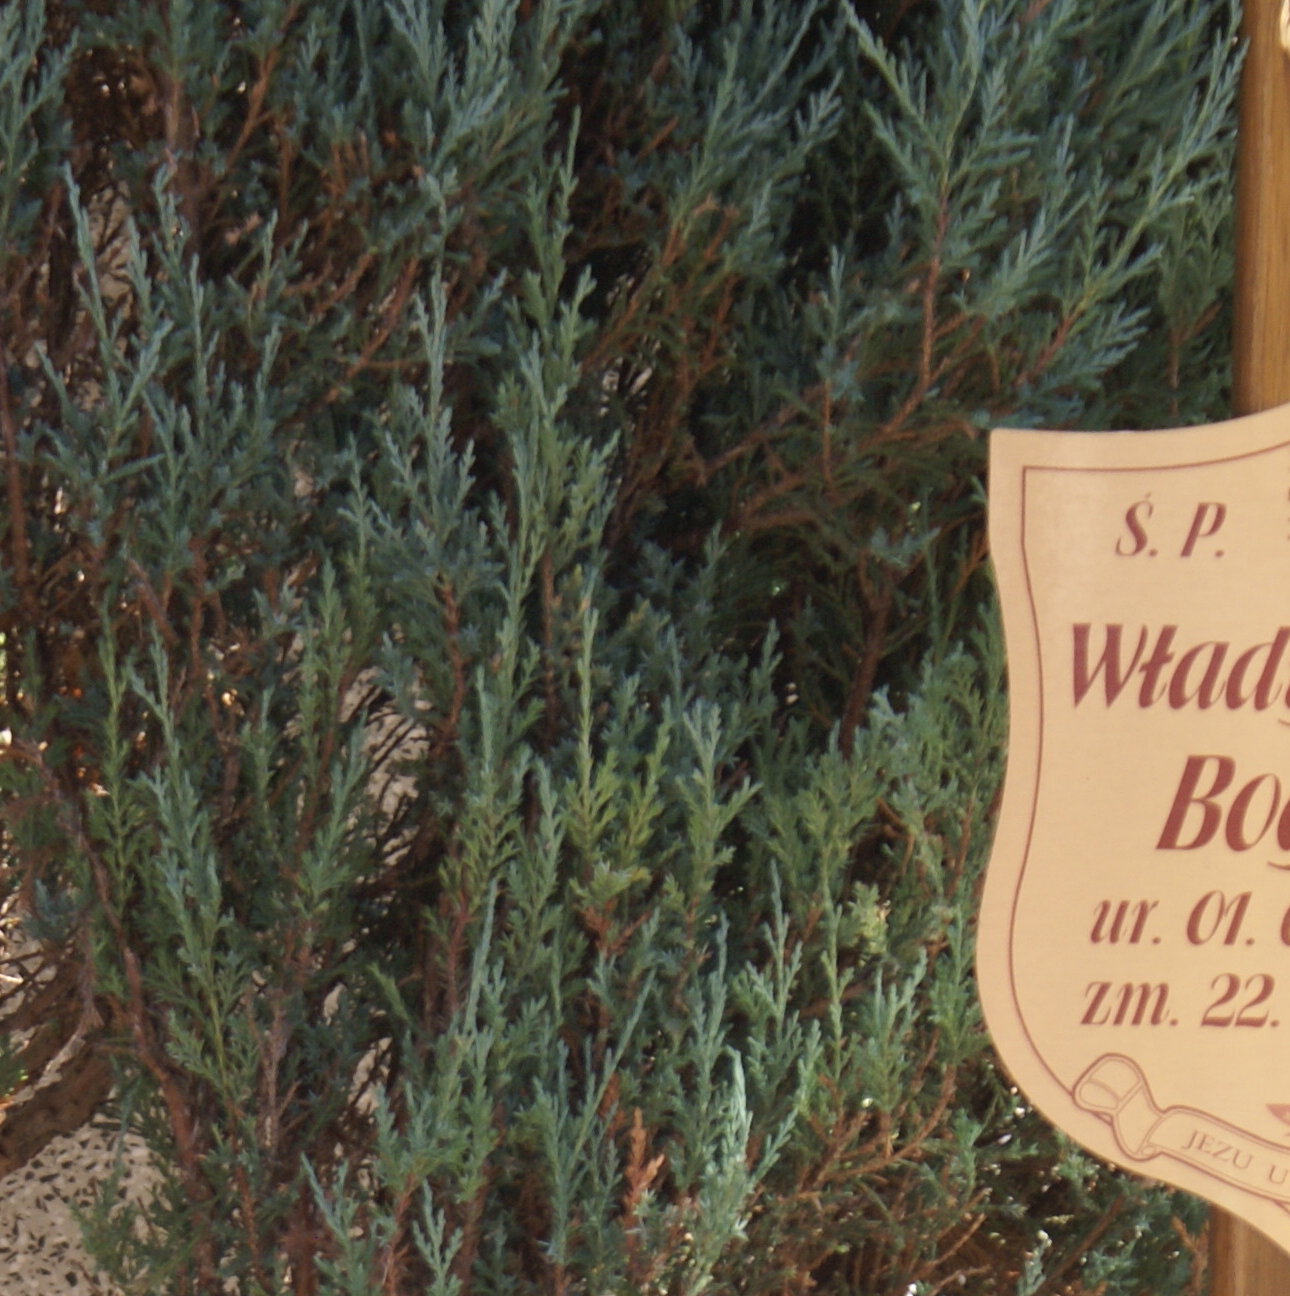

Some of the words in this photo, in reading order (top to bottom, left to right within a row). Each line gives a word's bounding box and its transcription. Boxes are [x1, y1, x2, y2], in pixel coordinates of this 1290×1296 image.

[1114, 491, 1158, 558] Ś.
[1179, 500, 1227, 559] P.
[1089, 896, 1162, 946] ur.
[1185, 890, 1255, 947] 01.
[1079, 979, 1179, 1027] zm.
[1200, 972, 1280, 1029] 22.
[1179, 1129, 1254, 1170] JEZU
